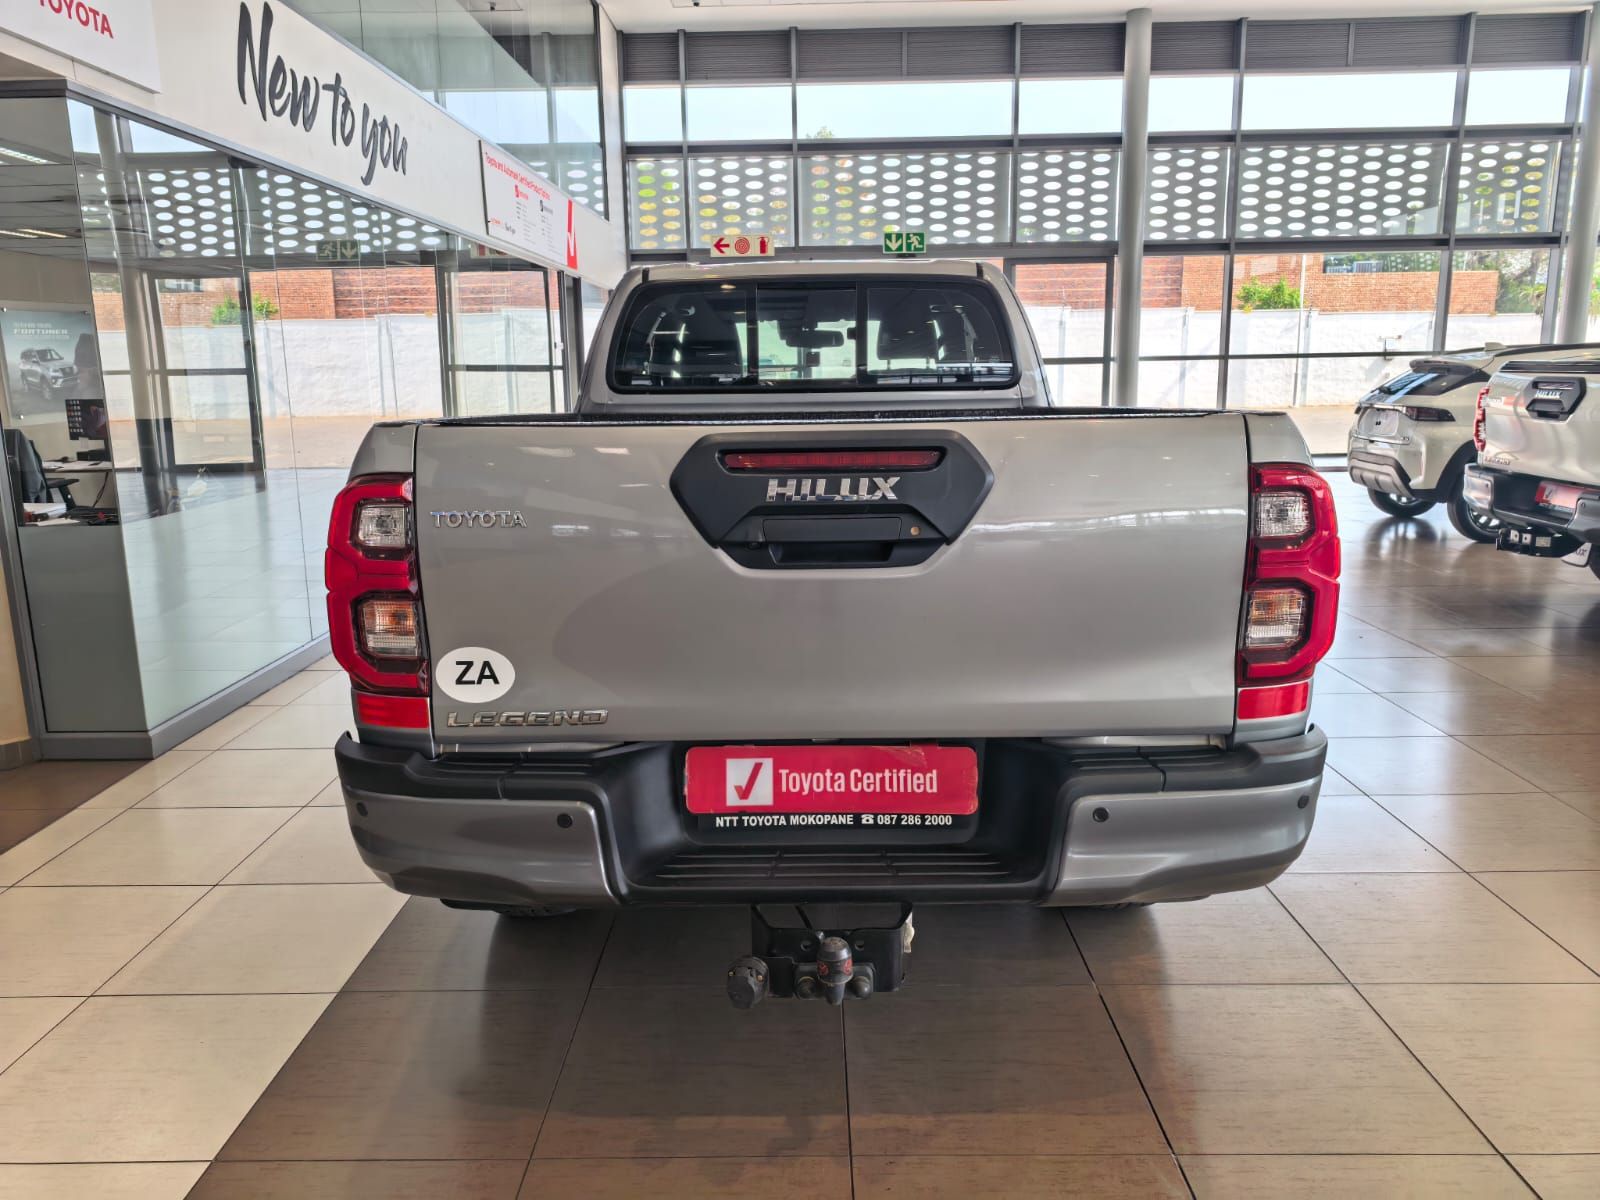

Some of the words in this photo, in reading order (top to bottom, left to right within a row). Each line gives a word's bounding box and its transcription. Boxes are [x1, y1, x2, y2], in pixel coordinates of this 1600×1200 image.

[39, 0, 114, 39] OYOTA
[237, 1, 320, 132] New
[322, 72, 355, 147] to
[361, 103, 408, 186] you
[766, 477, 900, 502] HILUX
[430, 510, 527, 528] TOYOTA
[455, 660, 500, 685] ZA
[447, 708, 609, 727] LEGEND
[778, 768, 846, 796] Toyota
[850, 768, 938, 793] Certified
[715, 816, 739, 828] NTT
[742, 815, 787, 827] TOYOTA
[790, 814, 854, 826] MOKOPANE
[877, 814, 898, 825] 087
[901, 814, 921, 825] 286
[924, 814, 952, 826] 2000
